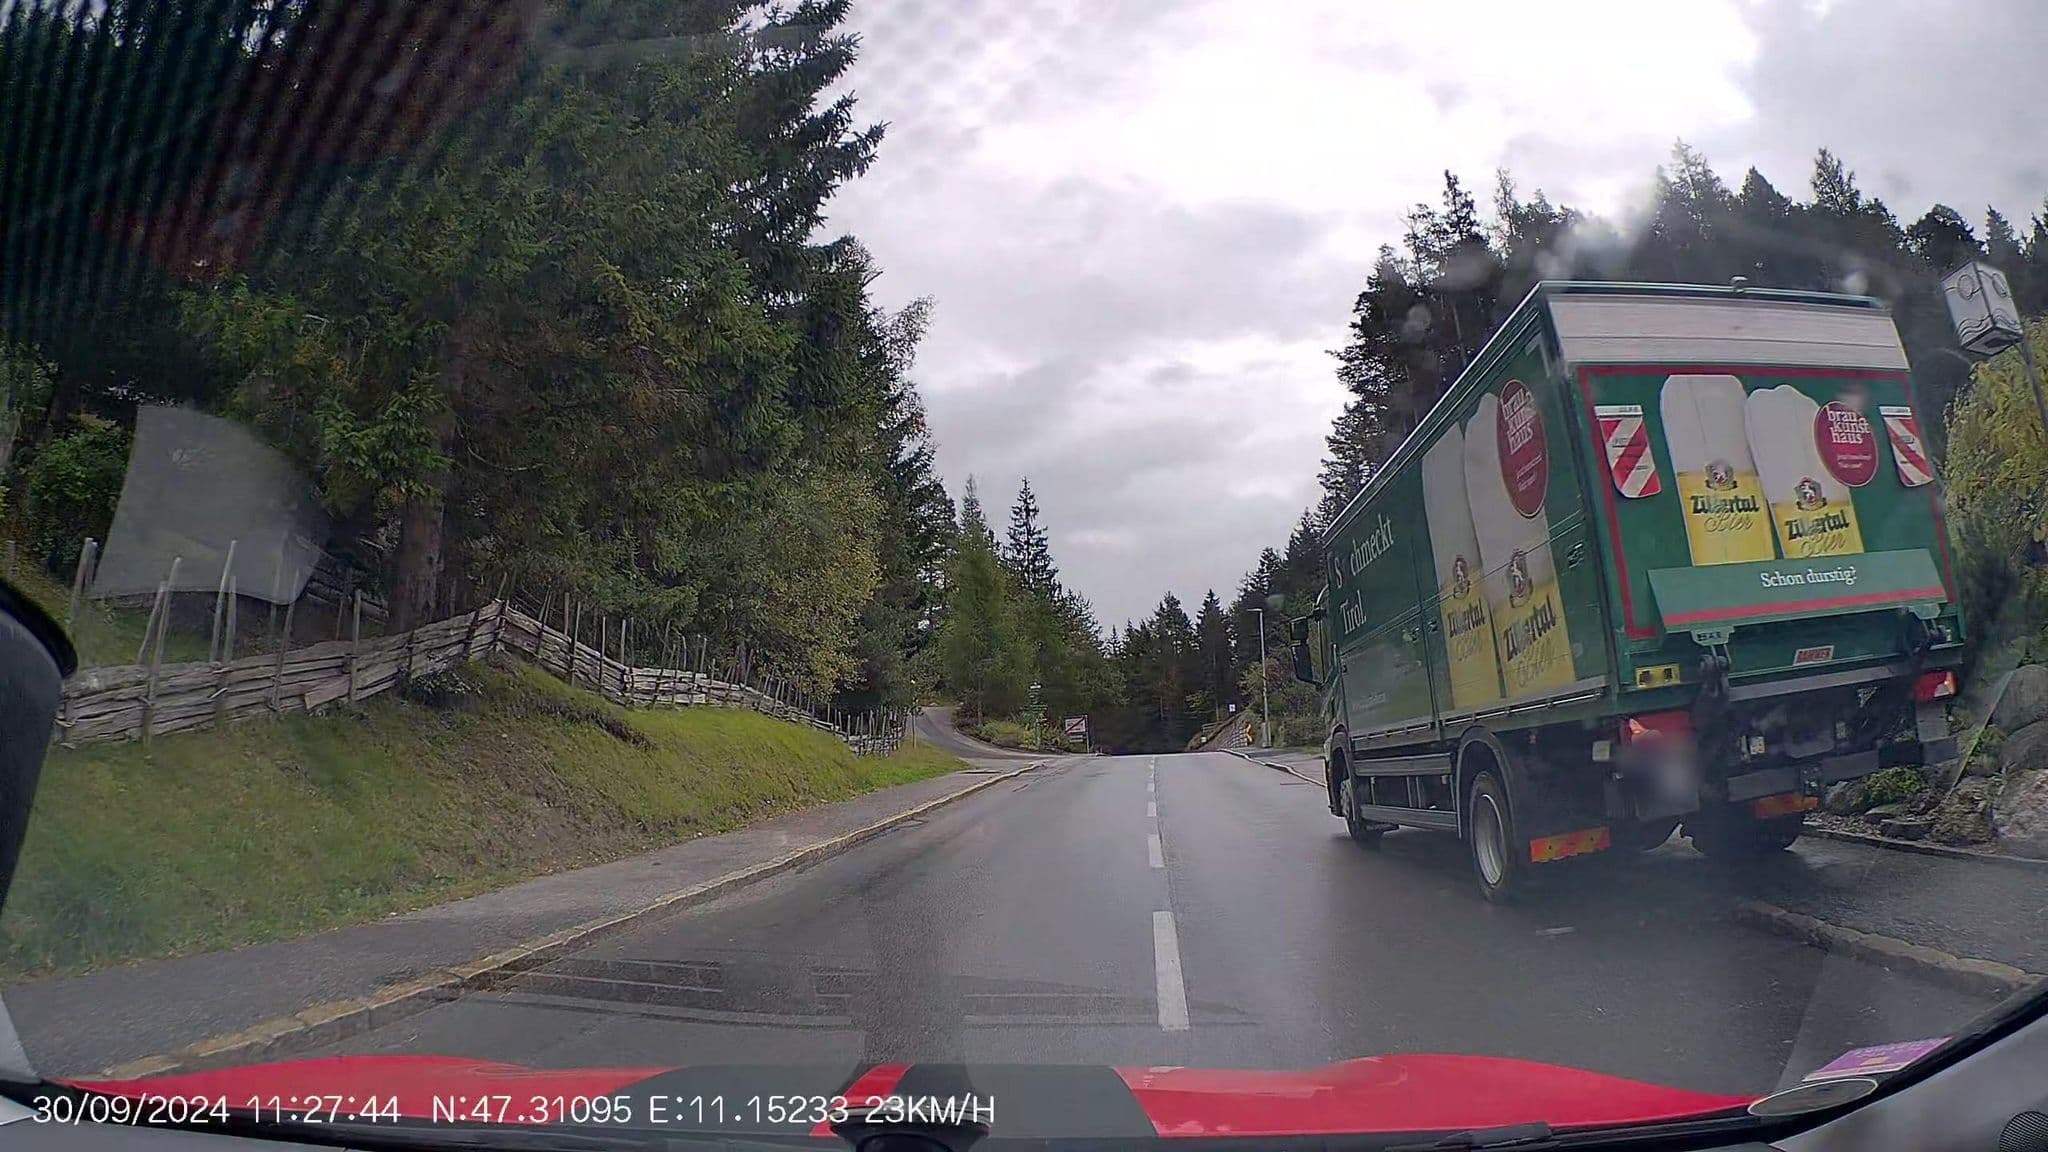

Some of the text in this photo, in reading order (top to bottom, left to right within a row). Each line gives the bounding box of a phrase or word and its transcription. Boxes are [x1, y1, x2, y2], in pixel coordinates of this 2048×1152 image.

[1833, 417, 1872, 434] kunst
[1829, 427, 1863, 444] haus
[1350, 512, 1394, 577] chmeckt
[1760, 566, 1857, 587] Schon durstig?
